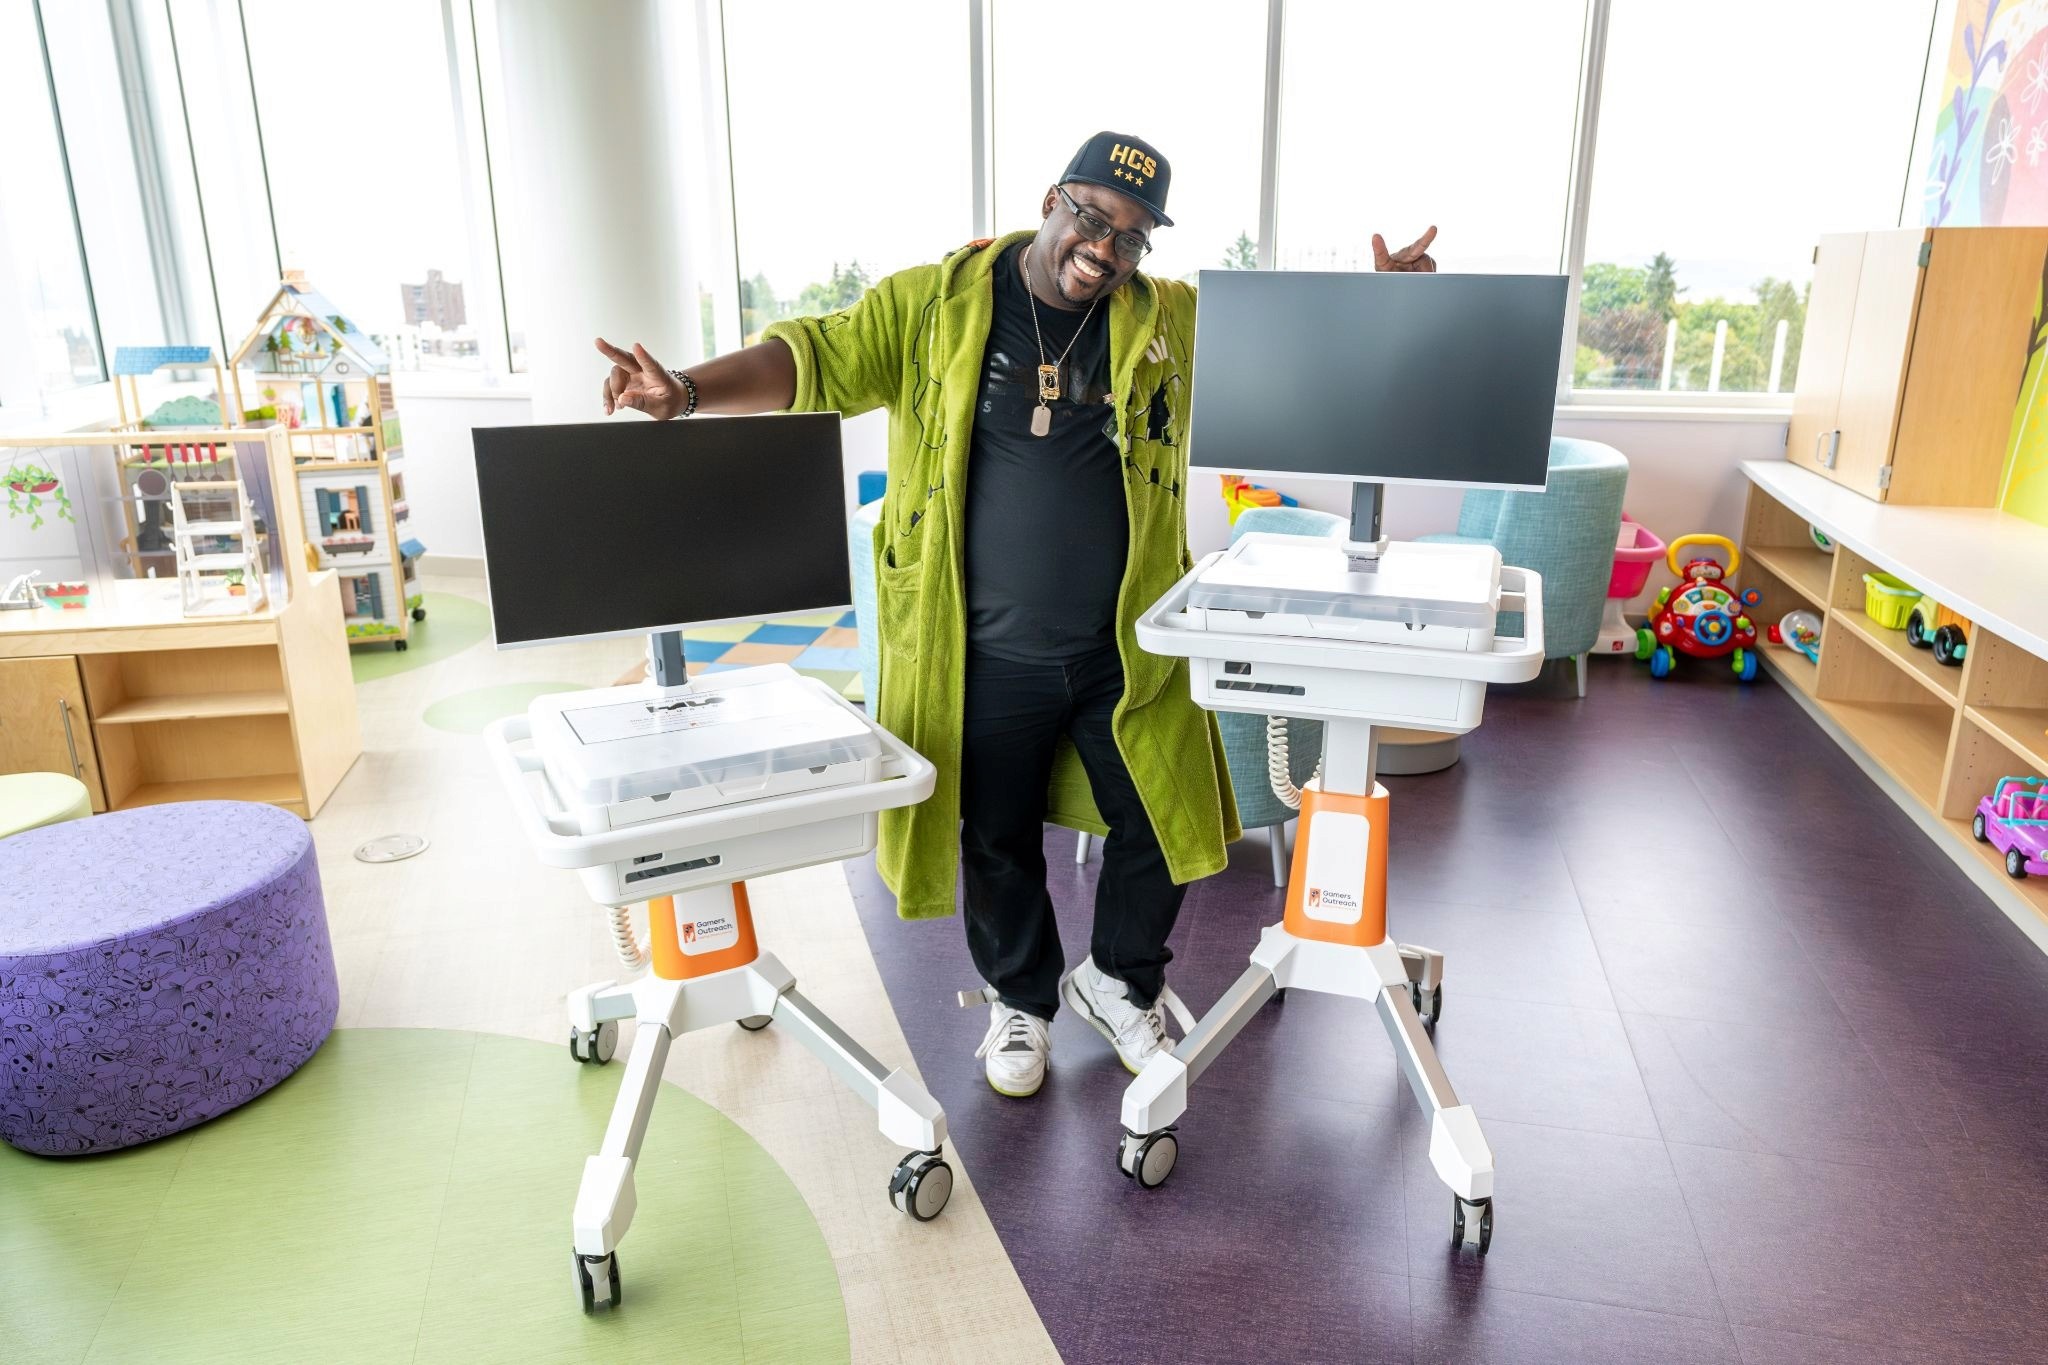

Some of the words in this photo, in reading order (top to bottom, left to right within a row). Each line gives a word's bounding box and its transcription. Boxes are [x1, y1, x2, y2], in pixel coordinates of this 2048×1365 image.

[1109, 143, 1157, 178] HCS
[1322, 890, 1351, 900] Gamers
[696, 917, 726, 928] Gamers
